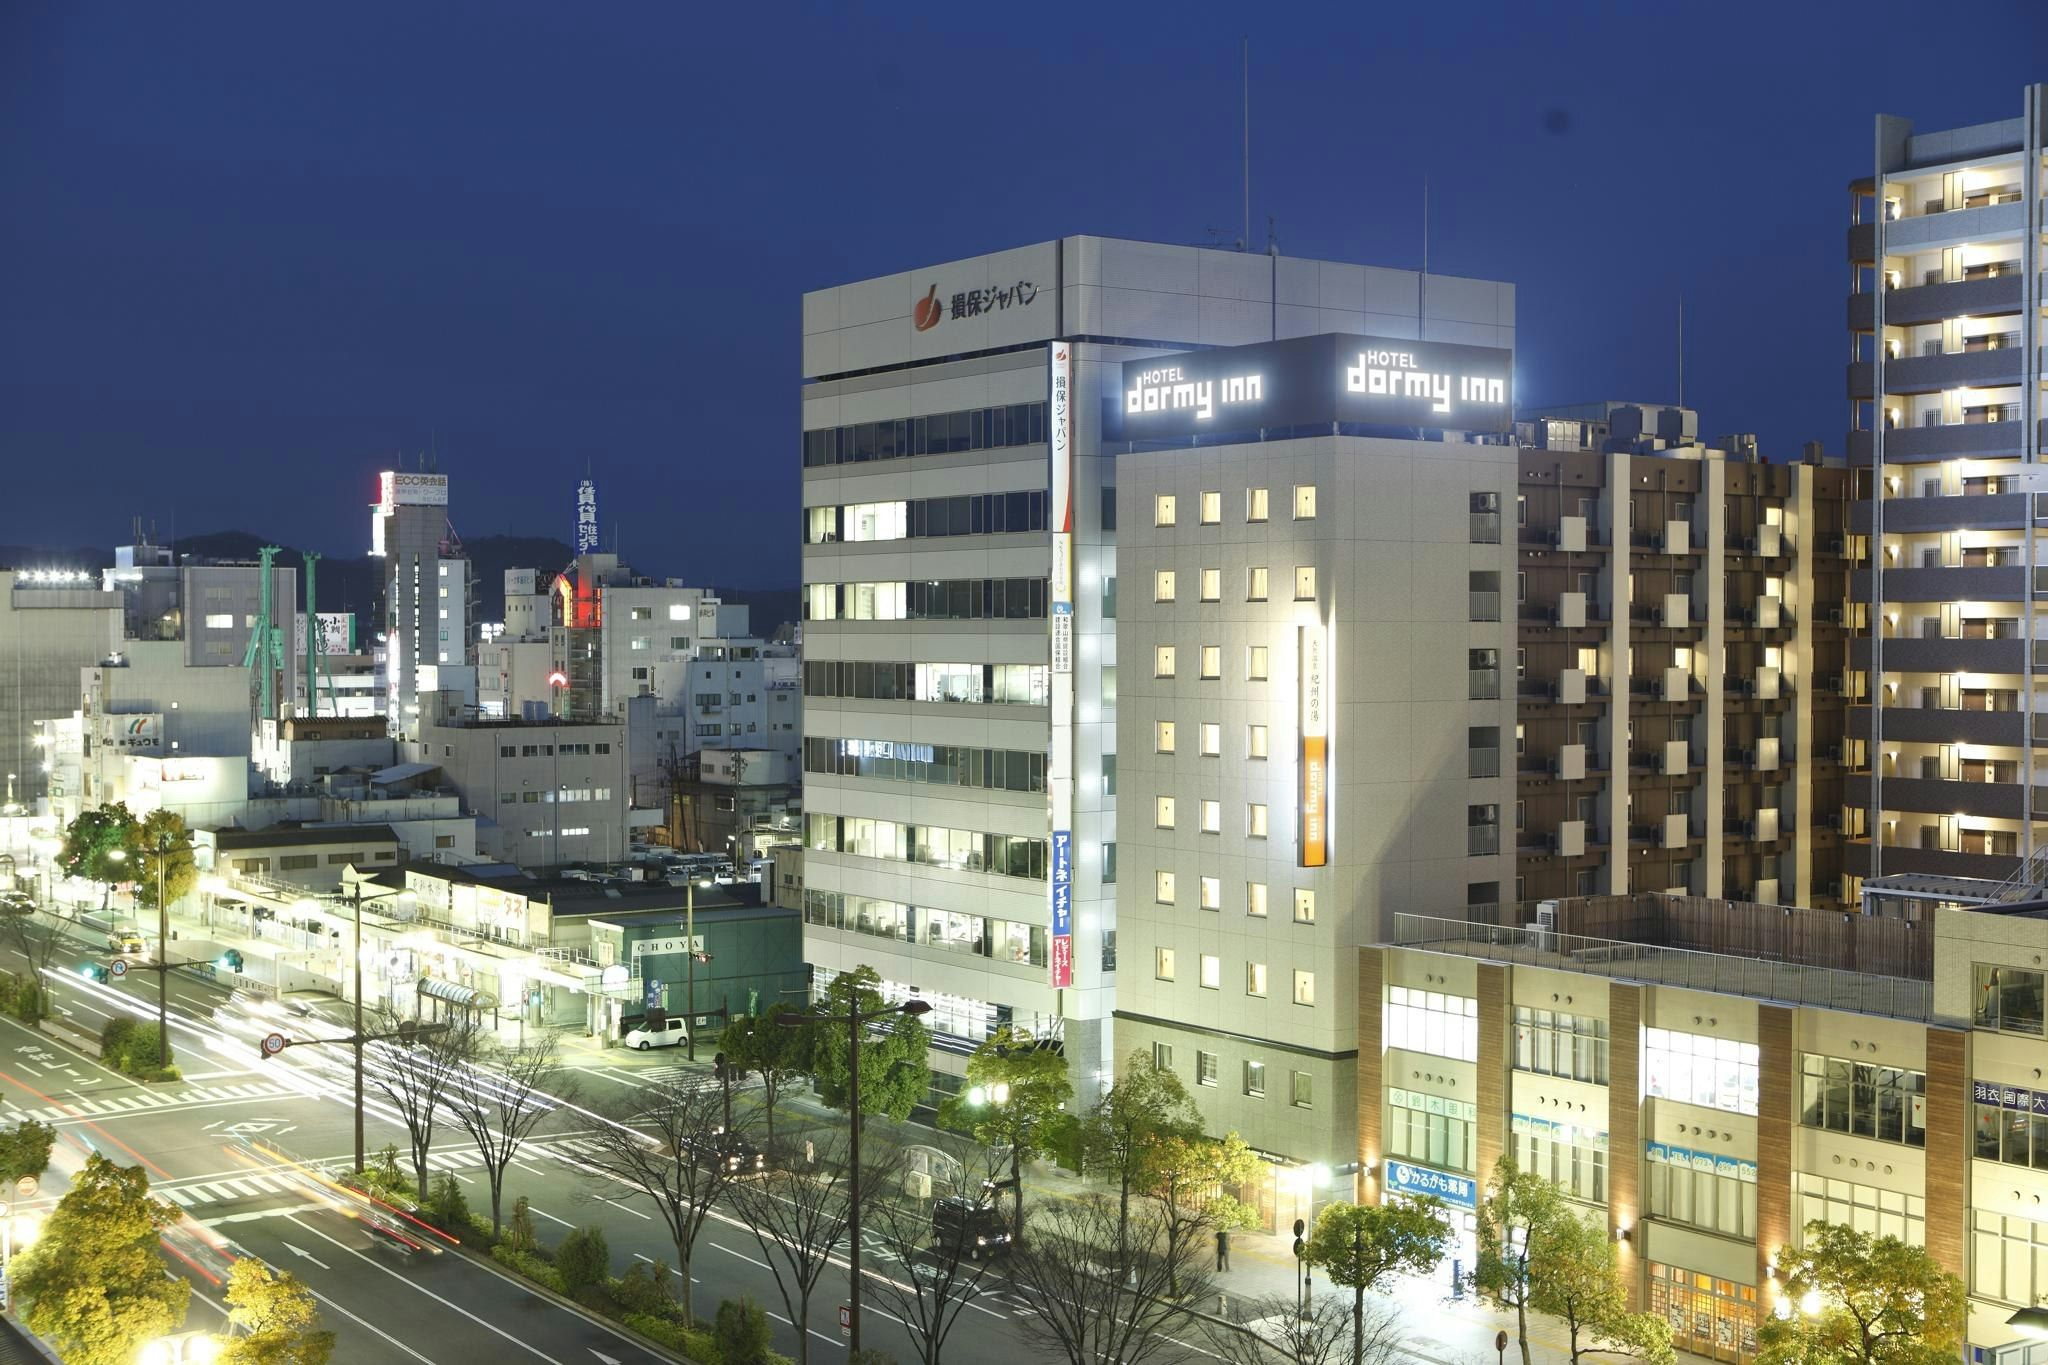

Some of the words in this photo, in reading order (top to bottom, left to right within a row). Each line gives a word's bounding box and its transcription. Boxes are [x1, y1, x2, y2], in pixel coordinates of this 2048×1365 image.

[951, 281, 1040, 320] 損保ジャパン
[1367, 350, 1418, 368] HOTEL
[1143, 367, 1185, 385] HOTEL
[1347, 354, 1451, 413] dormy
[1461, 376, 1504, 404] inn
[1127, 376, 1213, 419] dormy
[1222, 375, 1262, 403] inn
[1056, 376, 1066, 451] 損保ジャパン
[395, 476, 447, 487] ECC英会話
[1056, 835, 1067, 928] アートネイチャー
[637, 940, 700, 953] CHOYA
[269, 1039, 281, 1049] 50
[1975, 1085, 2048, 1110] 羽衣国際大
[1410, 1170, 1469, 1198] かるがも薬局
